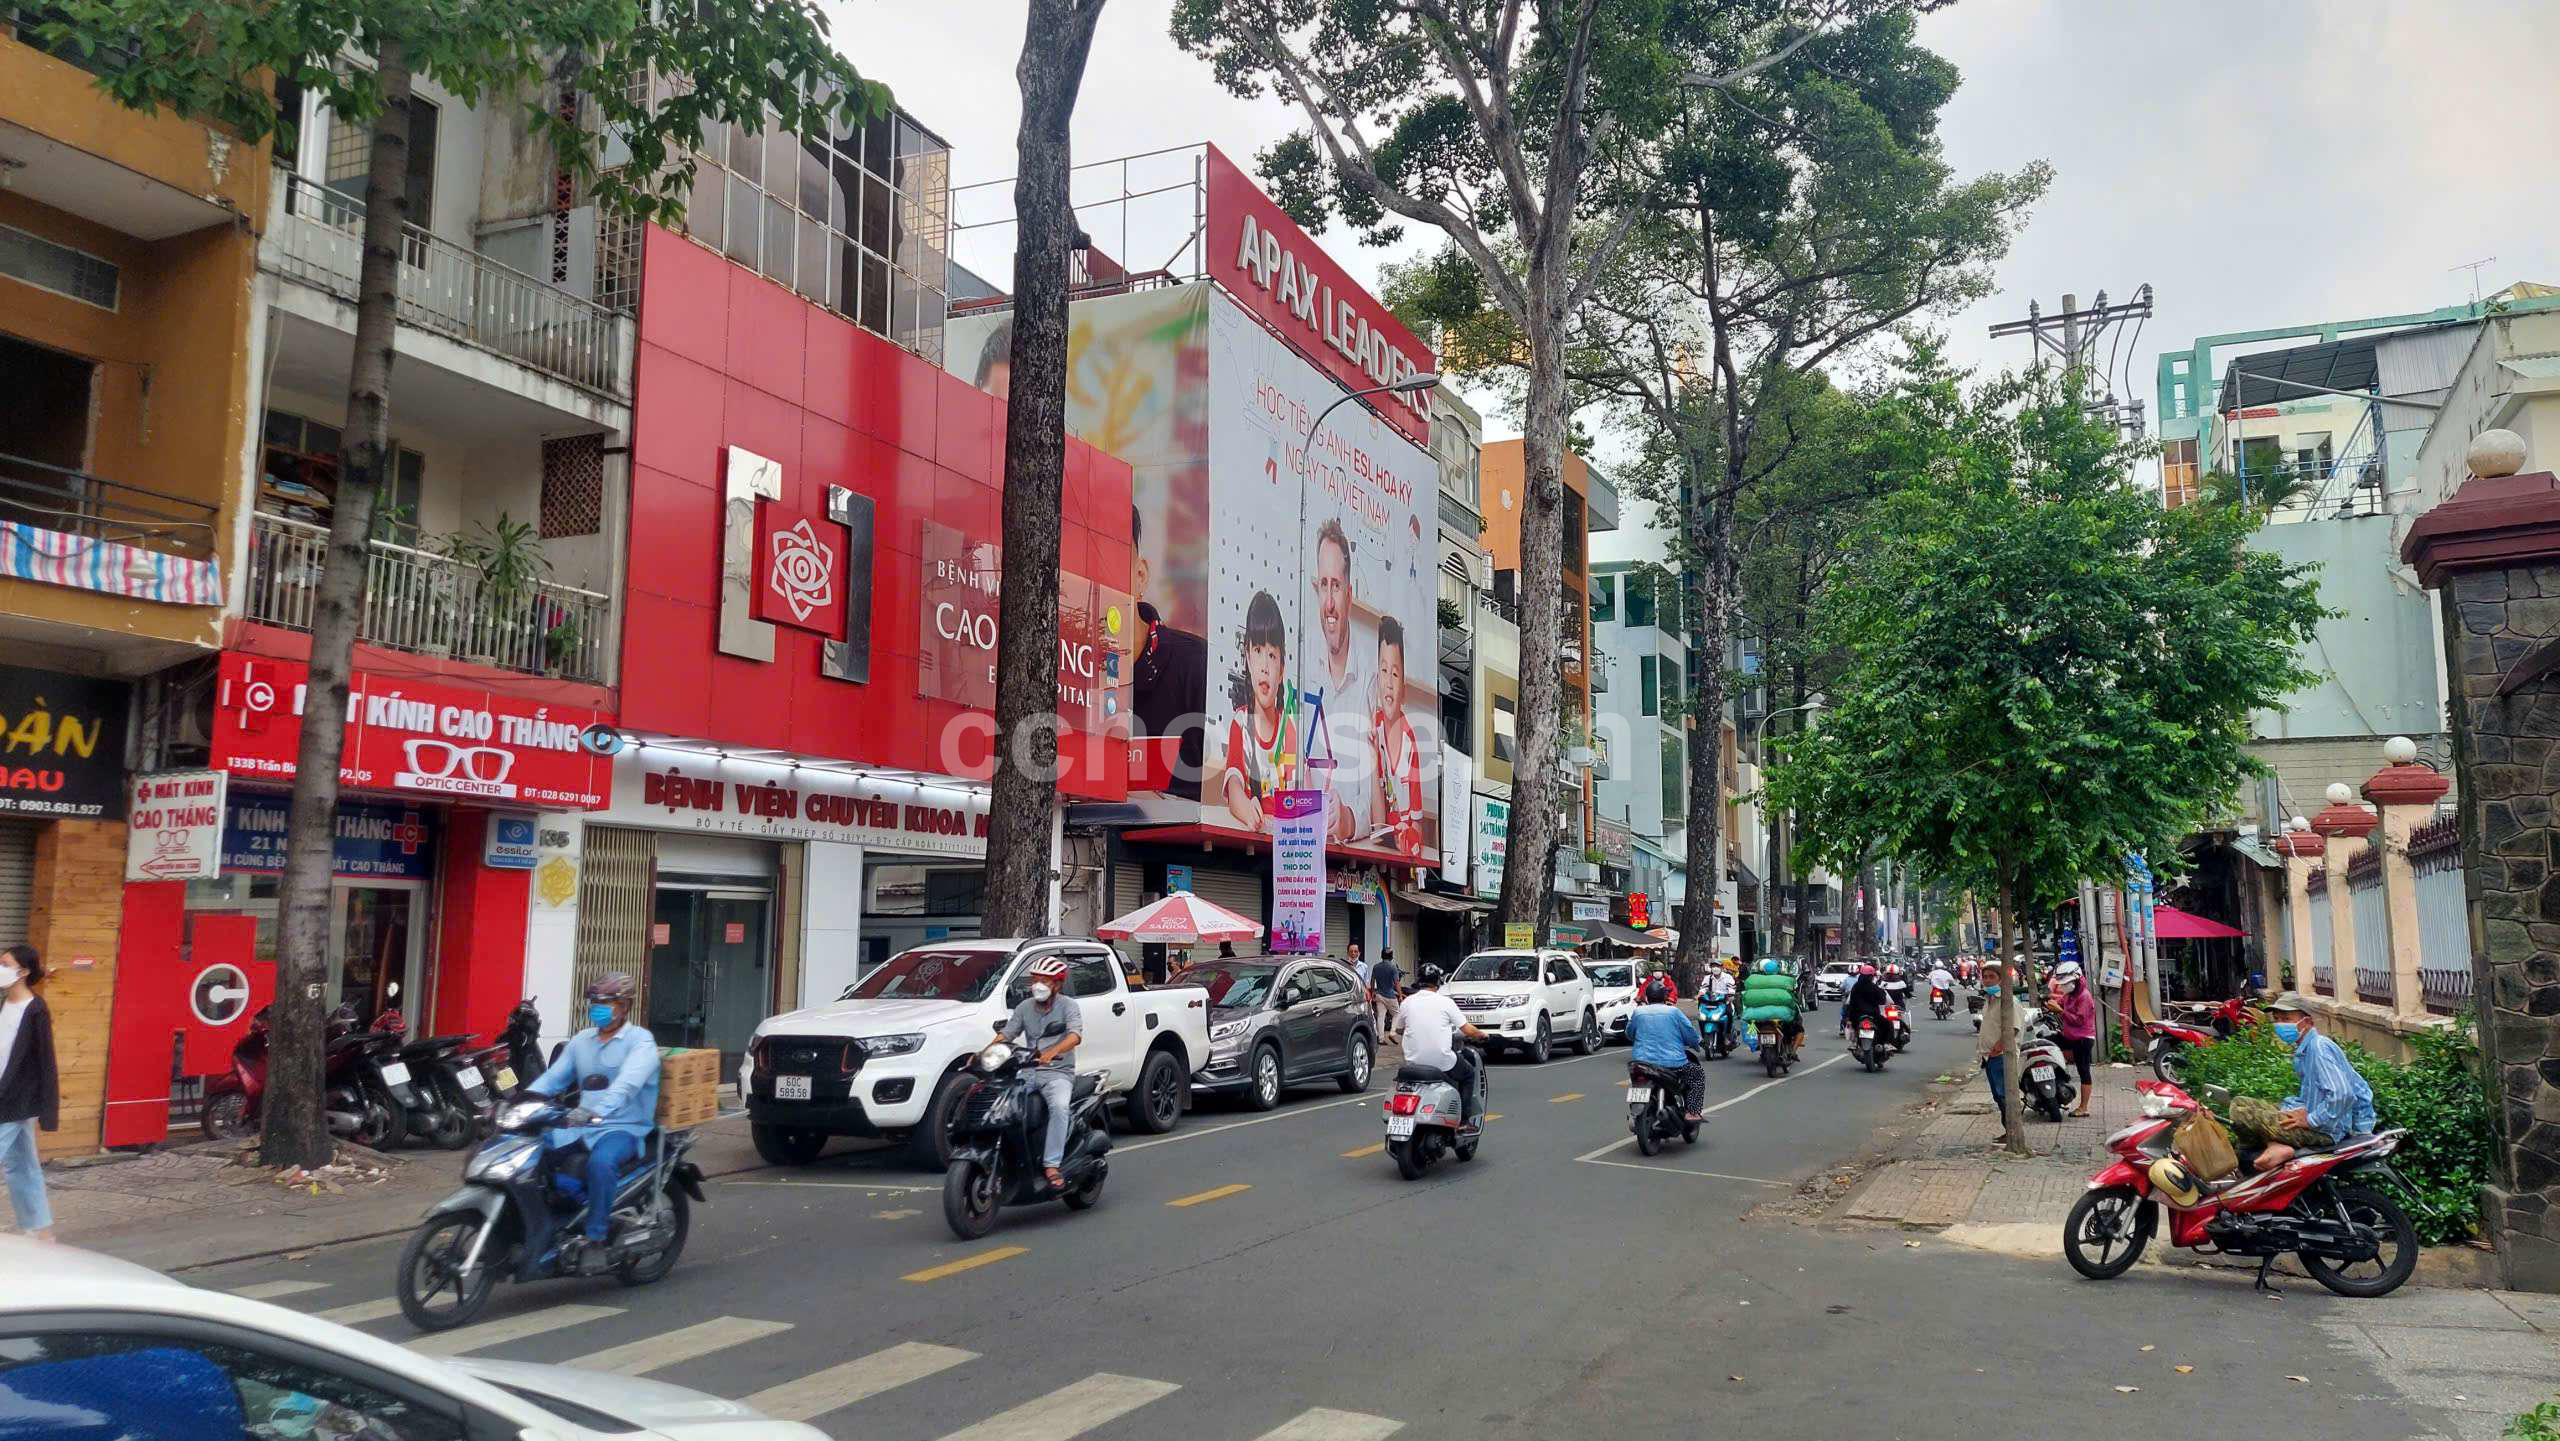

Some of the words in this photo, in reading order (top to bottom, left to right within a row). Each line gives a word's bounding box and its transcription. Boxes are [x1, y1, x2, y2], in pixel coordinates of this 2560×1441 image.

[1236, 214, 1318, 332] APAX
[1326, 430, 1350, 466] ANH
[1353, 447, 1374, 483] ESL
[1376, 463, 1397, 499] HOA
[1367, 495, 1391, 528] NAM
[937, 559, 979, 589] BỆNH
[987, 580, 1000, 597] VI
[936, 602, 997, 650] CAO
[1060, 638, 1094, 678] NG
[1056, 682, 1093, 708] ITAL
[0, 697, 100, 758] ÀN
[366, 691, 436, 733] KÍNH
[440, 706, 493, 741] CAO
[498, 707, 579, 752] THẮNG
[185, 779, 214, 797] KÍNH
[415, 776, 452, 790] OPTIC
[455, 781, 502, 795] CENTER
[542, 789, 557, 801] 028
[559, 790, 579, 803] 6291
[19, 799, 104, 816] 0903.681.927
[644, 766, 725, 814] BỆNH
[735, 779, 798, 824] VIỆN
[804, 793, 899, 831] CHUYÊN
[904, 804, 967, 836] KHOA
[133, 810, 162, 829] CAO
[238, 802, 286, 833] KÍNH
[719, 820, 725, 829] Y
[350, 861, 371, 872] CAO
[786, 1077, 801, 1088] 60C
